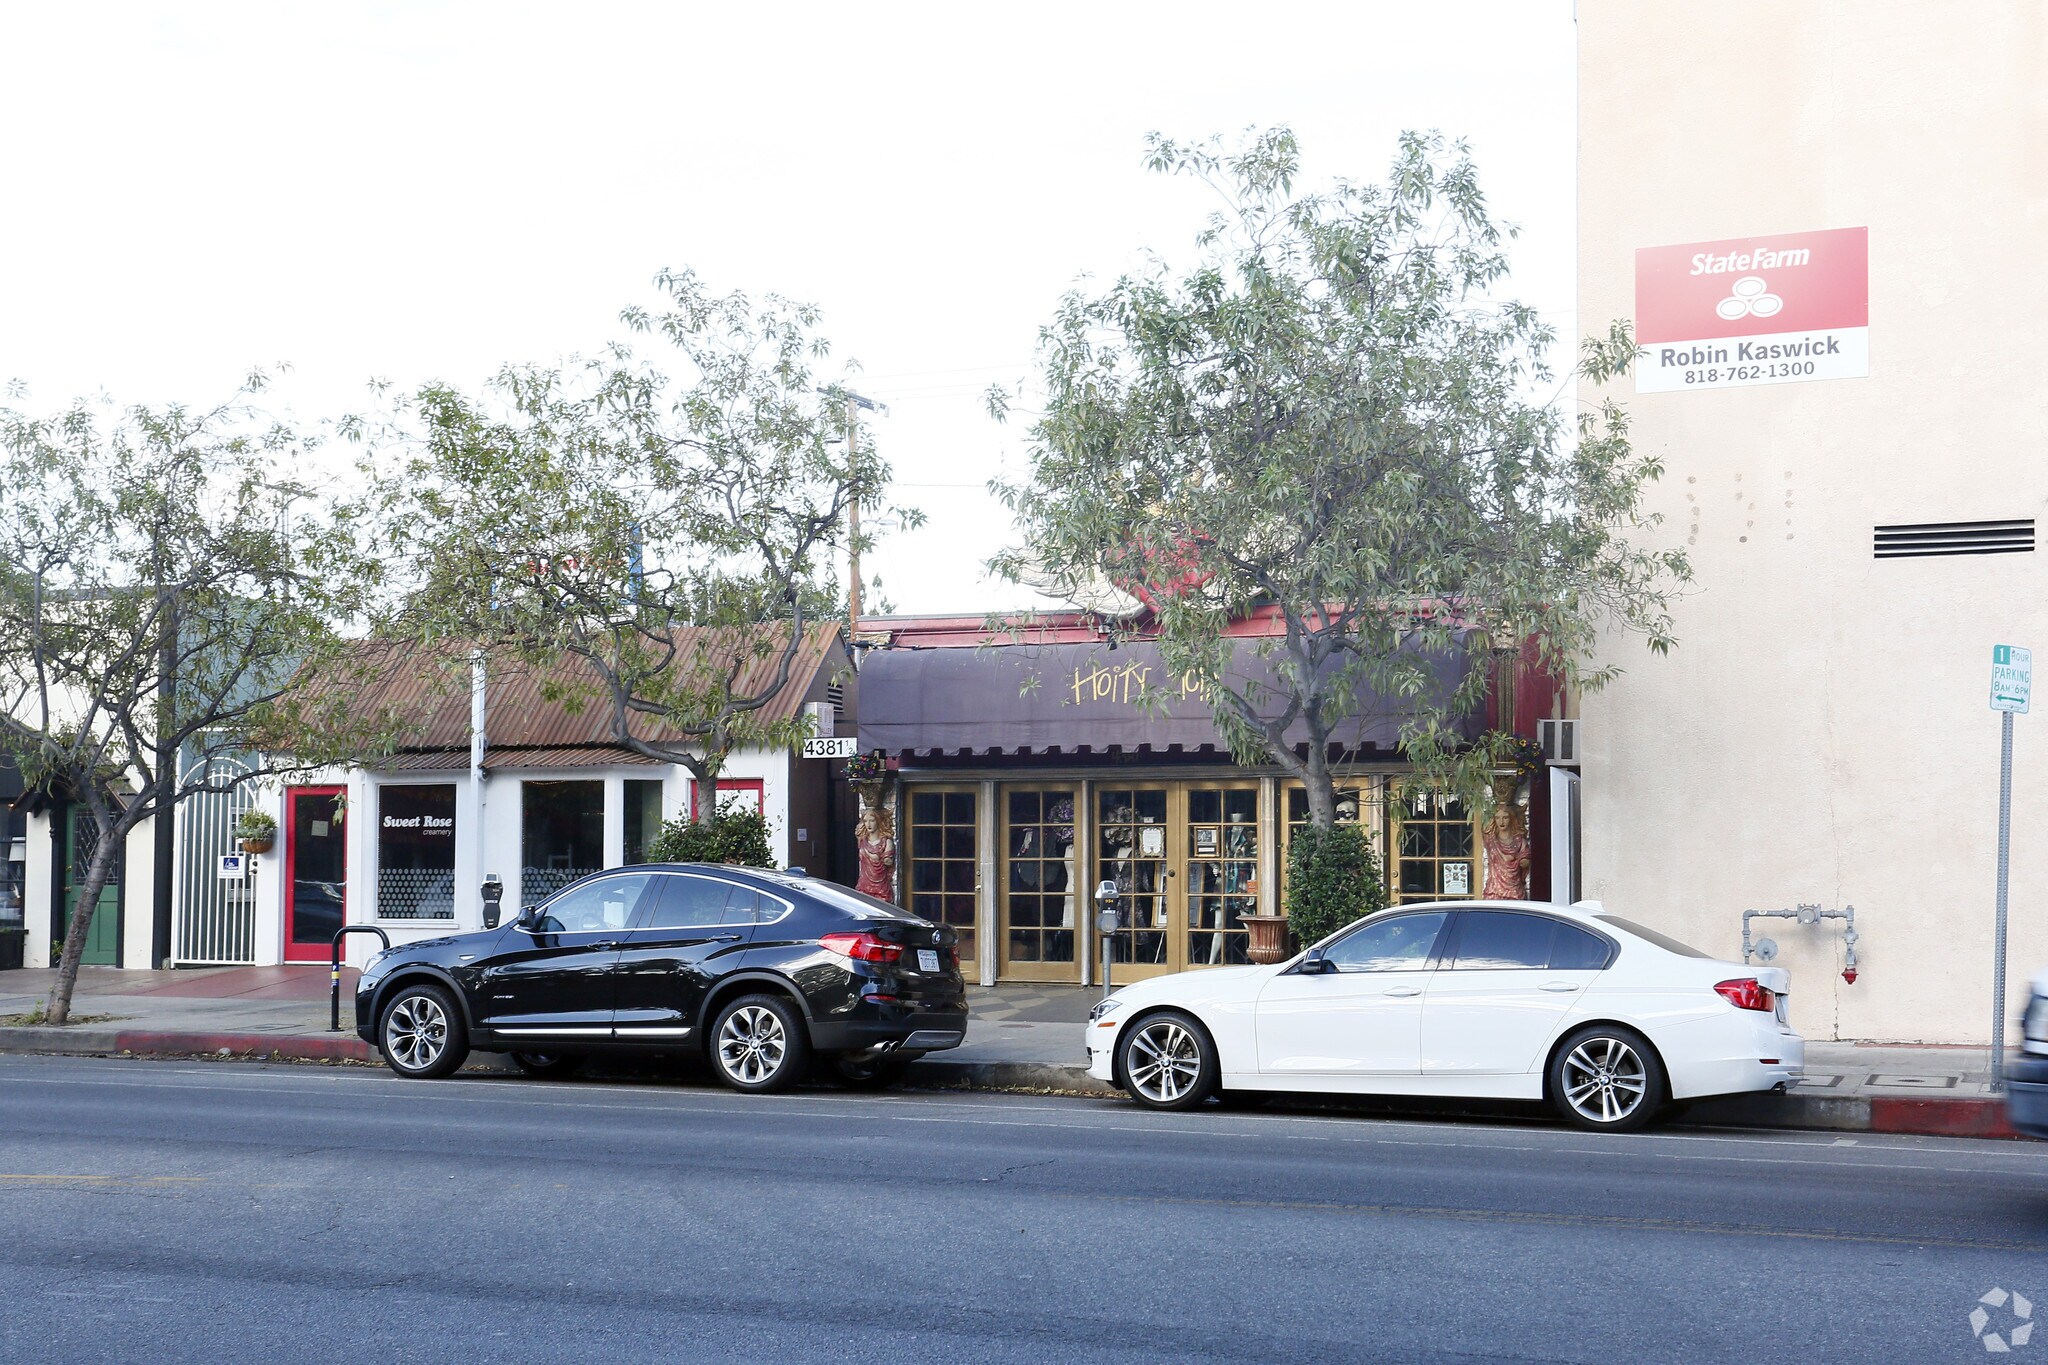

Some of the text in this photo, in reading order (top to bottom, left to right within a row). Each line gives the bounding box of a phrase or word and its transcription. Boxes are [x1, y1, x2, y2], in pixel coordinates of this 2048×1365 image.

[1661, 336, 1840, 367] Robin Kaswick
[1685, 362, 1814, 383] 818-762-1300
[1999, 647, 2030, 663] 1 HOUR
[1994, 667, 2030, 684] PARKING
[1994, 681, 2029, 695] 8AM 6PM
[805, 740, 843, 755] 4381
[383, 815, 452, 828] Sweet Rose
[423, 829, 452, 837] creamery
